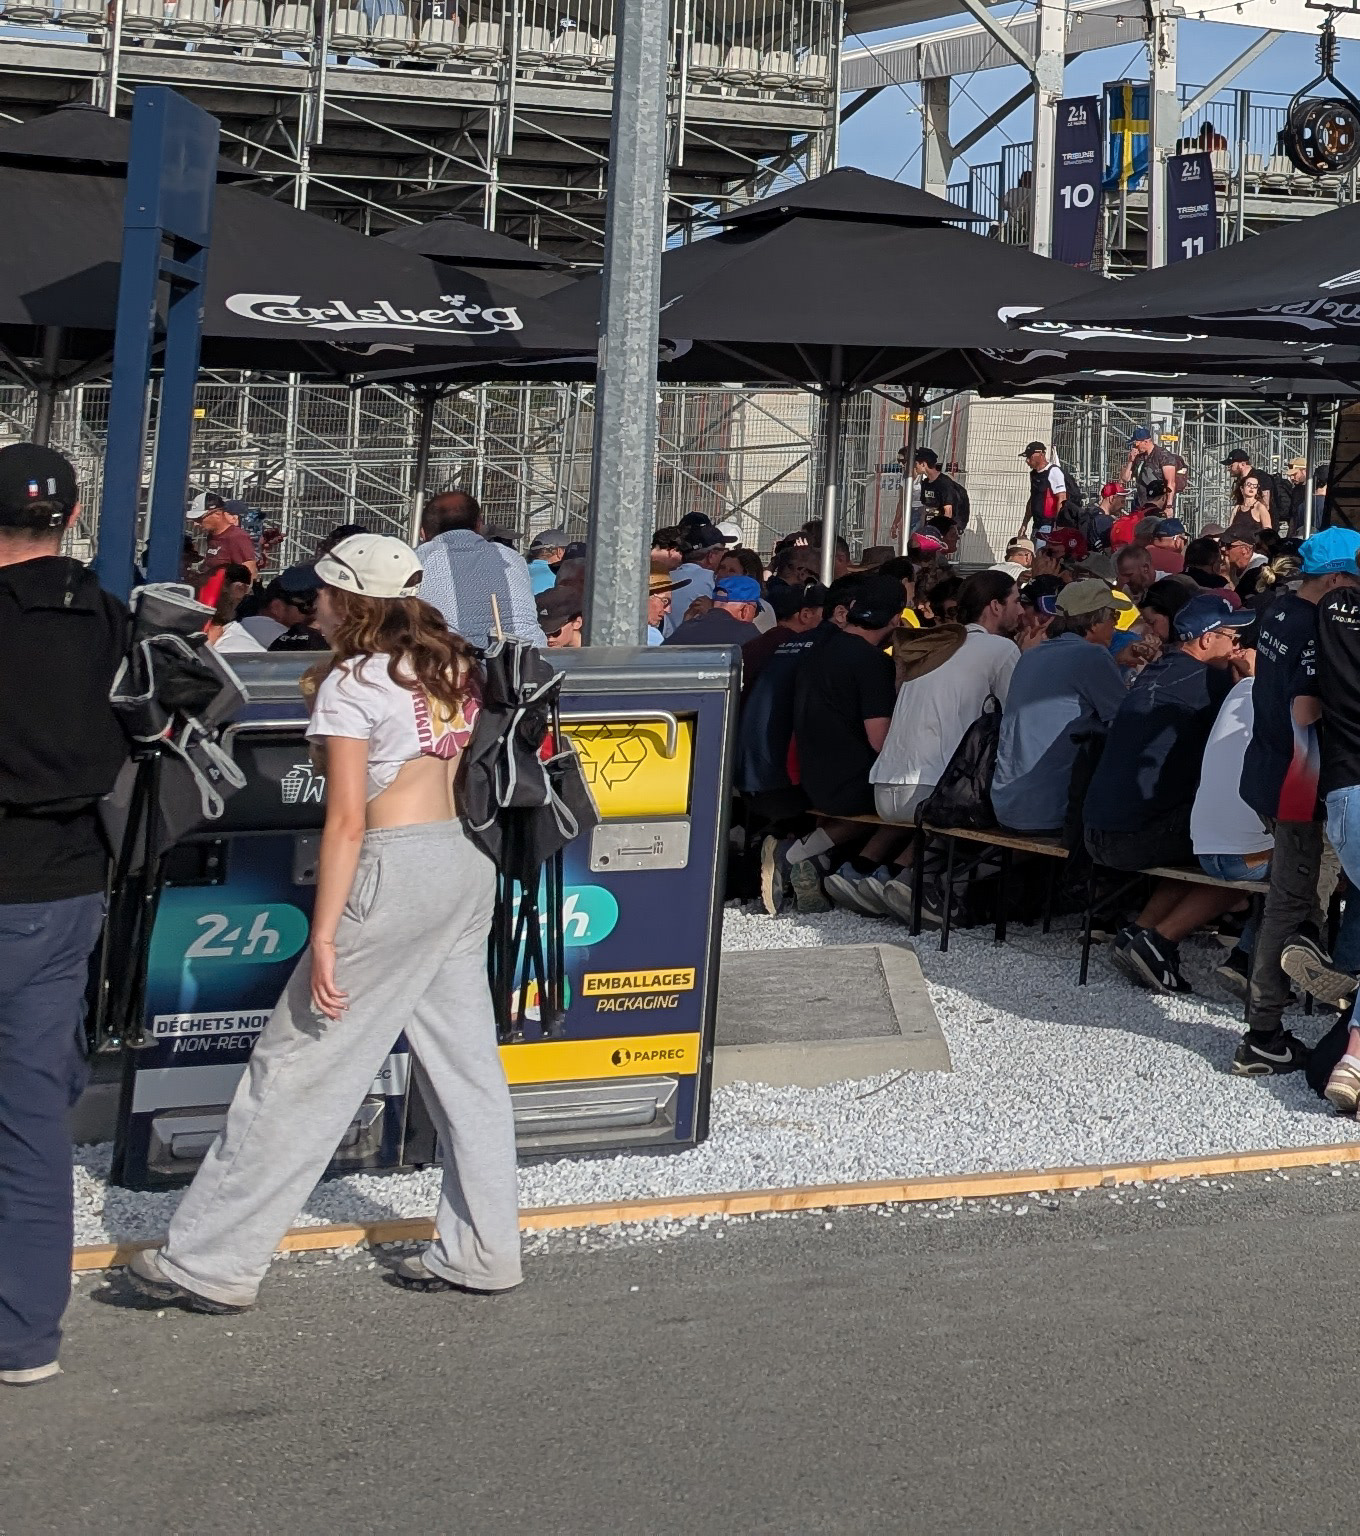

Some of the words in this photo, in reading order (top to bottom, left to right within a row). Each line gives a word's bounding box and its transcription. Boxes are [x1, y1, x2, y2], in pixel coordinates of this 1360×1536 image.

[1060, 184, 1095, 209] 10
[1181, 236, 1204, 260] 11
[225, 293, 524, 335] Carlsberg
[184, 911, 281, 958] 24h
[586, 972, 692, 991] EMBALLAGES
[596, 994, 680, 1013] PACKAGING
[156, 1016, 234, 1035] DÉCHETS
[173, 1034, 259, 1053] NON-RECY
[633, 1048, 685, 1062] PAPREC
